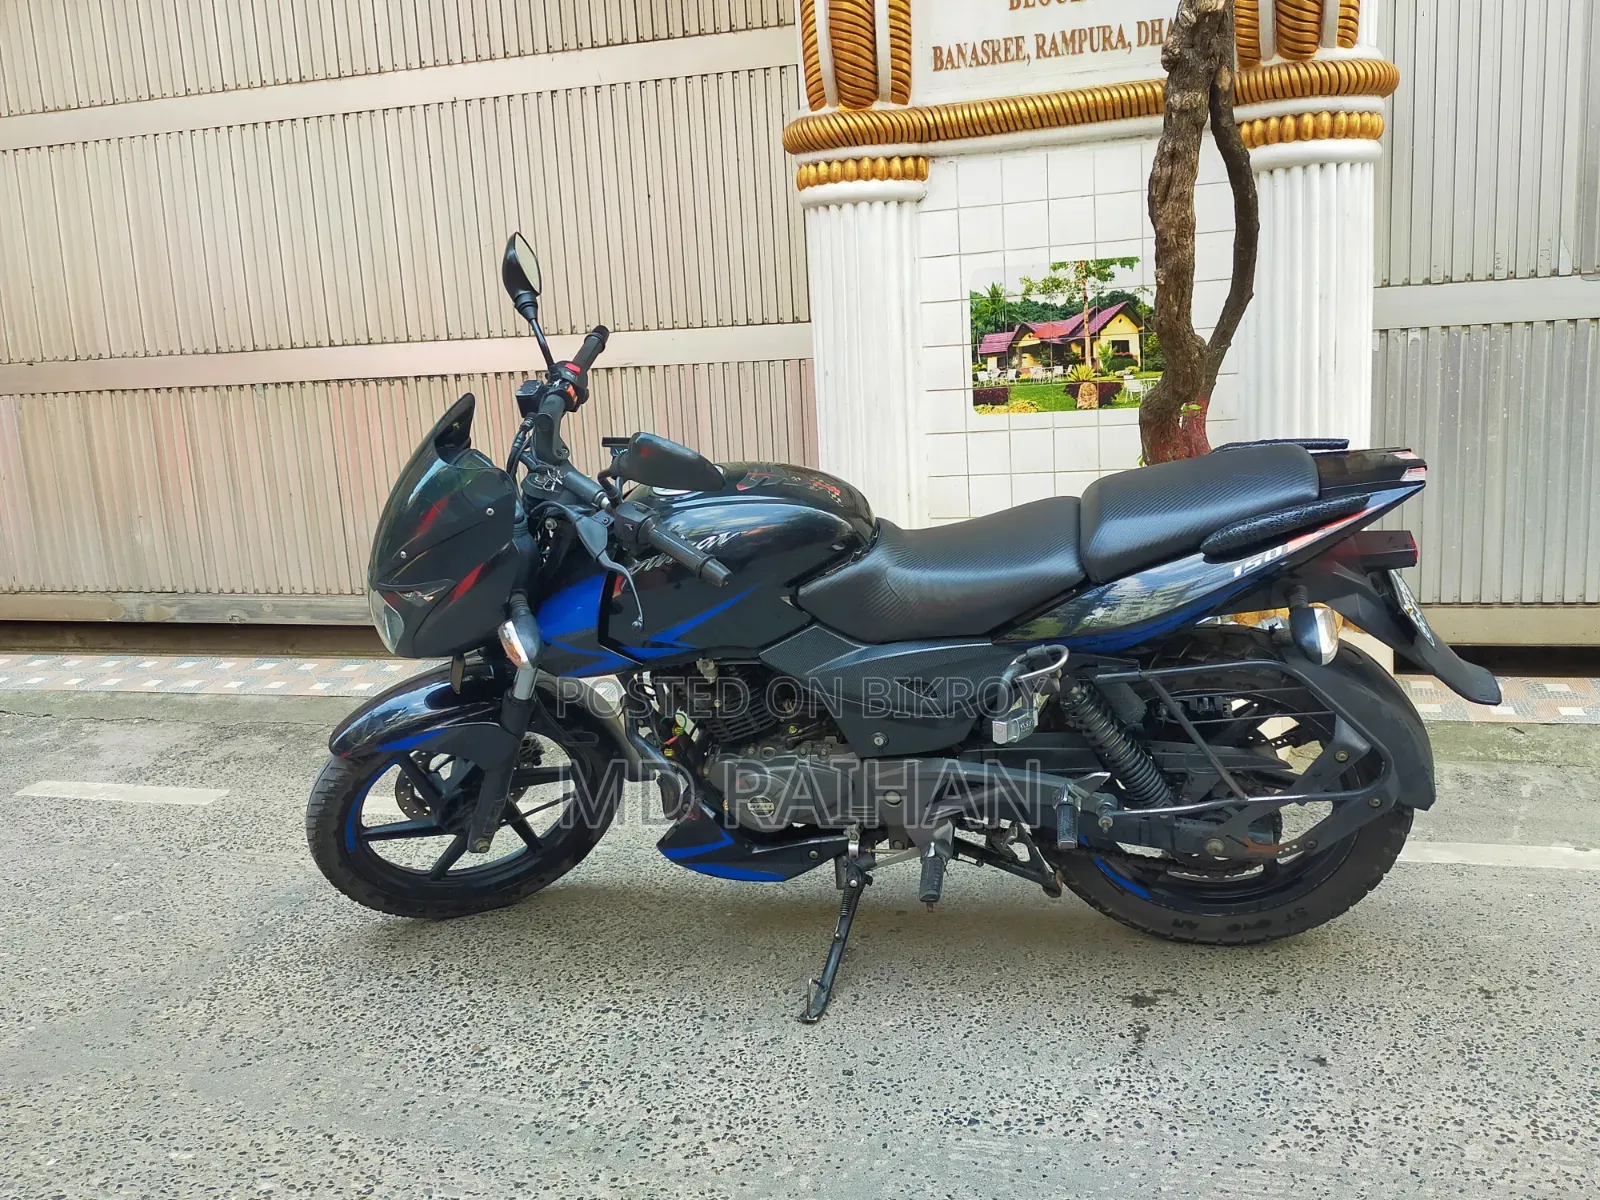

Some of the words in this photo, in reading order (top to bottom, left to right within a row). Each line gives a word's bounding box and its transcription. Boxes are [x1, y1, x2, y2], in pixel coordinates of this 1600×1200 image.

[932, 35, 1031, 72] BANASREE,
[1034, 23, 1132, 60] RAMPURA,
[1232, 547, 1282, 578] 150
